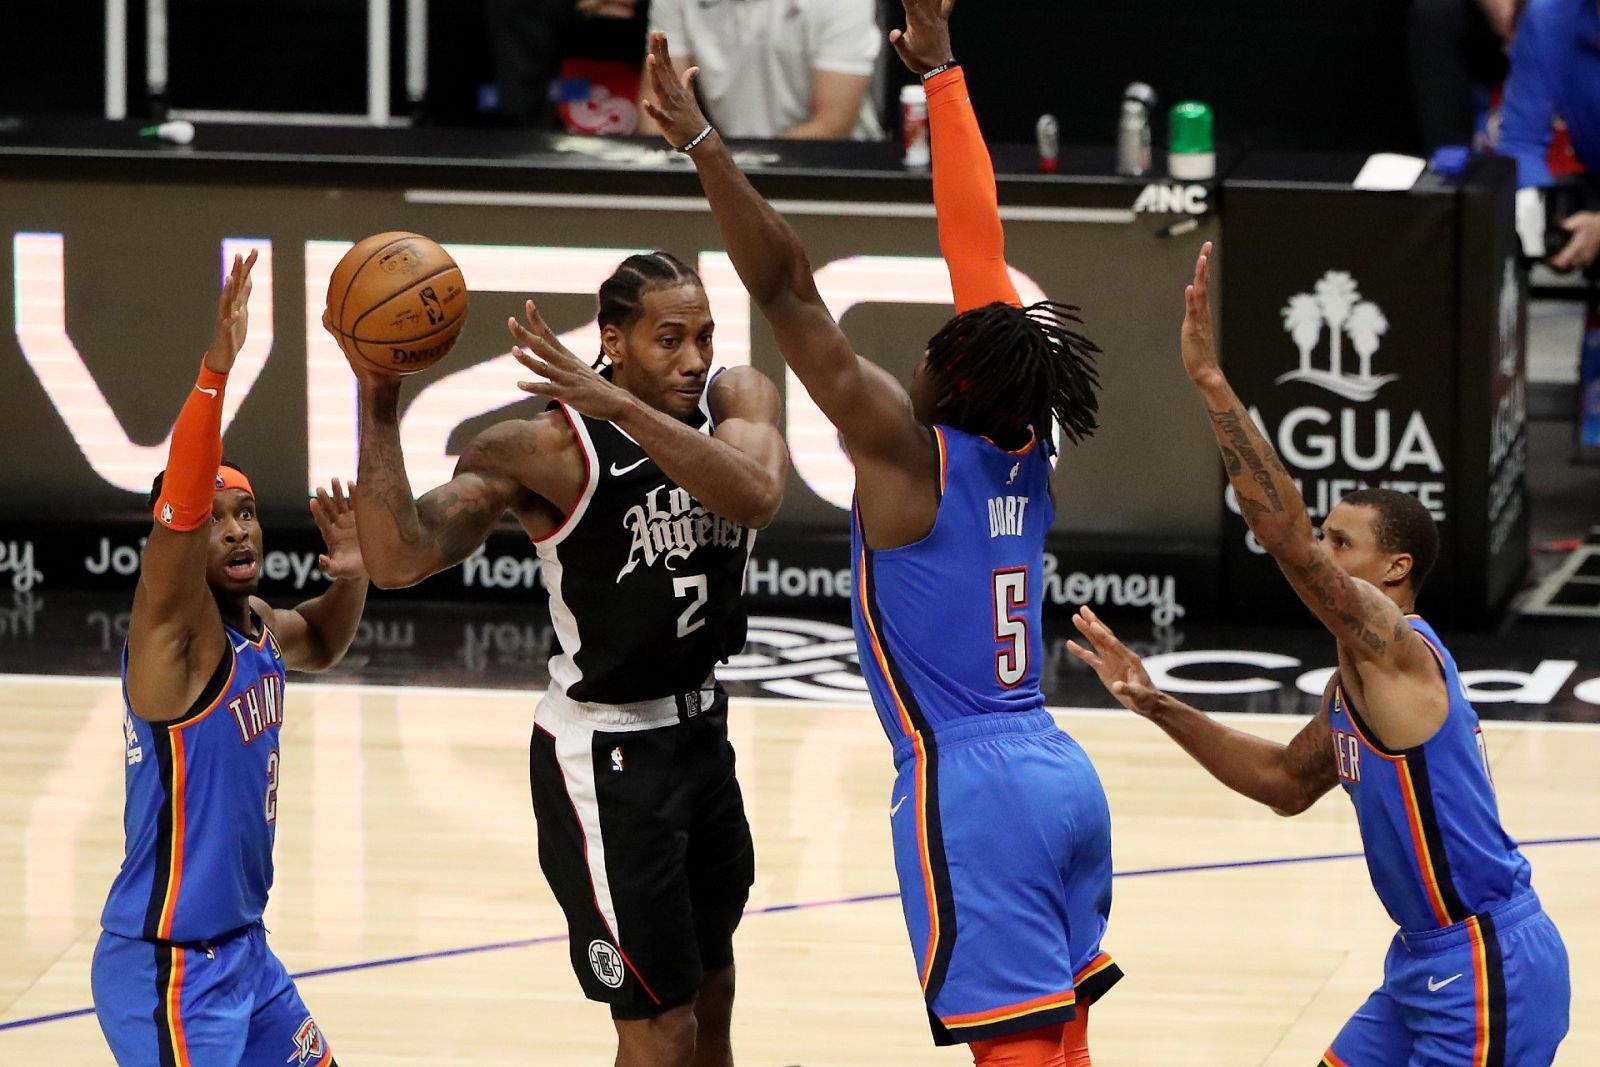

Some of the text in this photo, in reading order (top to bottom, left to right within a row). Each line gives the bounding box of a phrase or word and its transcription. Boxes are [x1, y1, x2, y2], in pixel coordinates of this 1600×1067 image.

[1134, 184, 1208, 214] ANC
[646, 484, 703, 524] Lo
[988, 496, 1029, 538] DORT
[463, 543, 547, 589] hon
[616, 505, 742, 583] Angeles
[672, 573, 707, 638] 2
[1043, 552, 1185, 626] honey
[993, 566, 1029, 689] 5
[265, 750, 280, 824] 2
